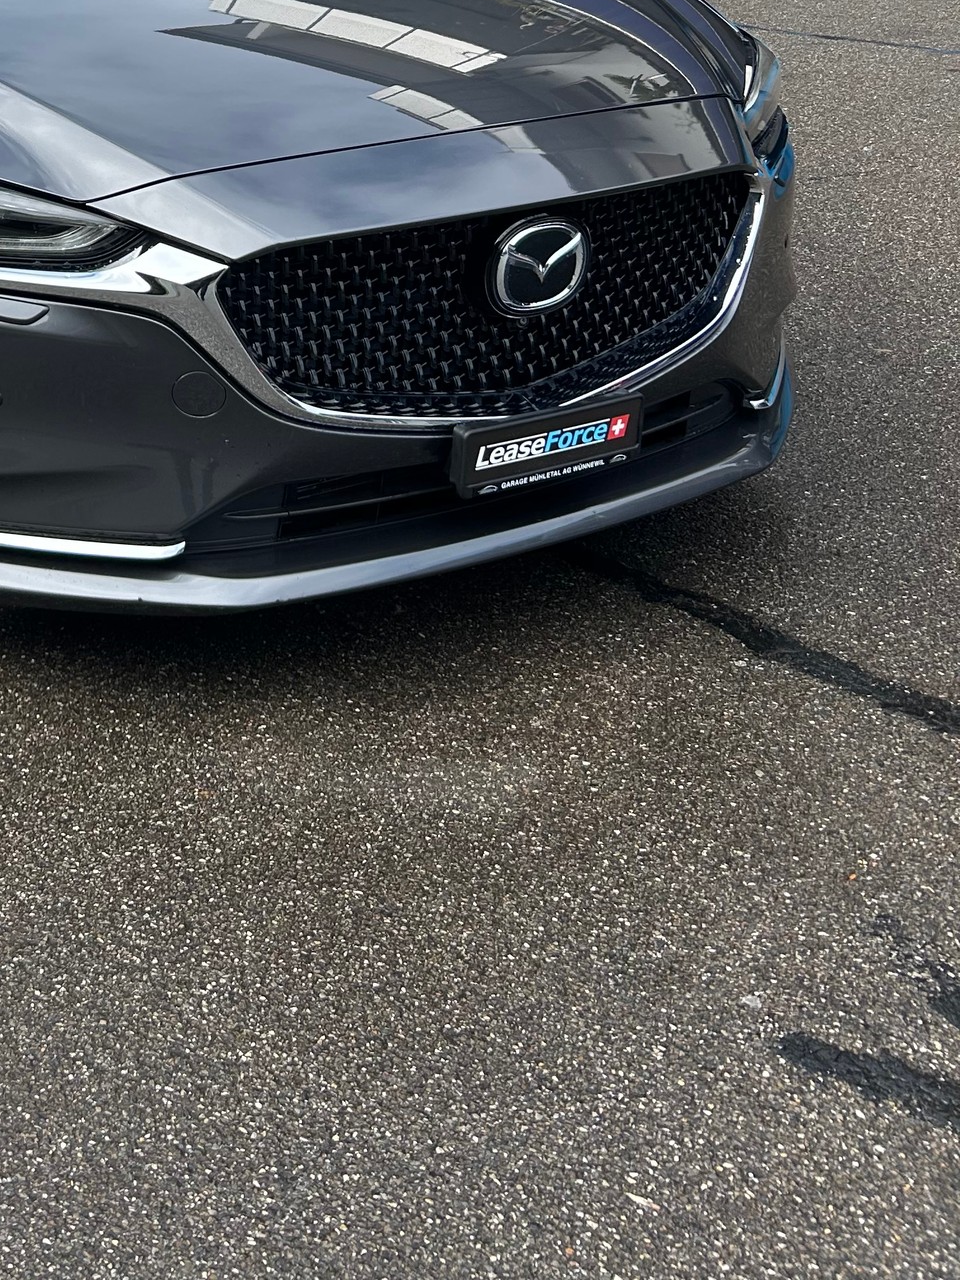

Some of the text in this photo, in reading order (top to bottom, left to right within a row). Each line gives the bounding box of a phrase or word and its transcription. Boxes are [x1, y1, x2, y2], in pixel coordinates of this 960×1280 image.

[475, 422, 609, 468] LeaseForce
[501, 476, 528, 489] GARAGE
[529, 470, 562, 483] MÜHLETAL
[562, 466, 572, 475] AG
